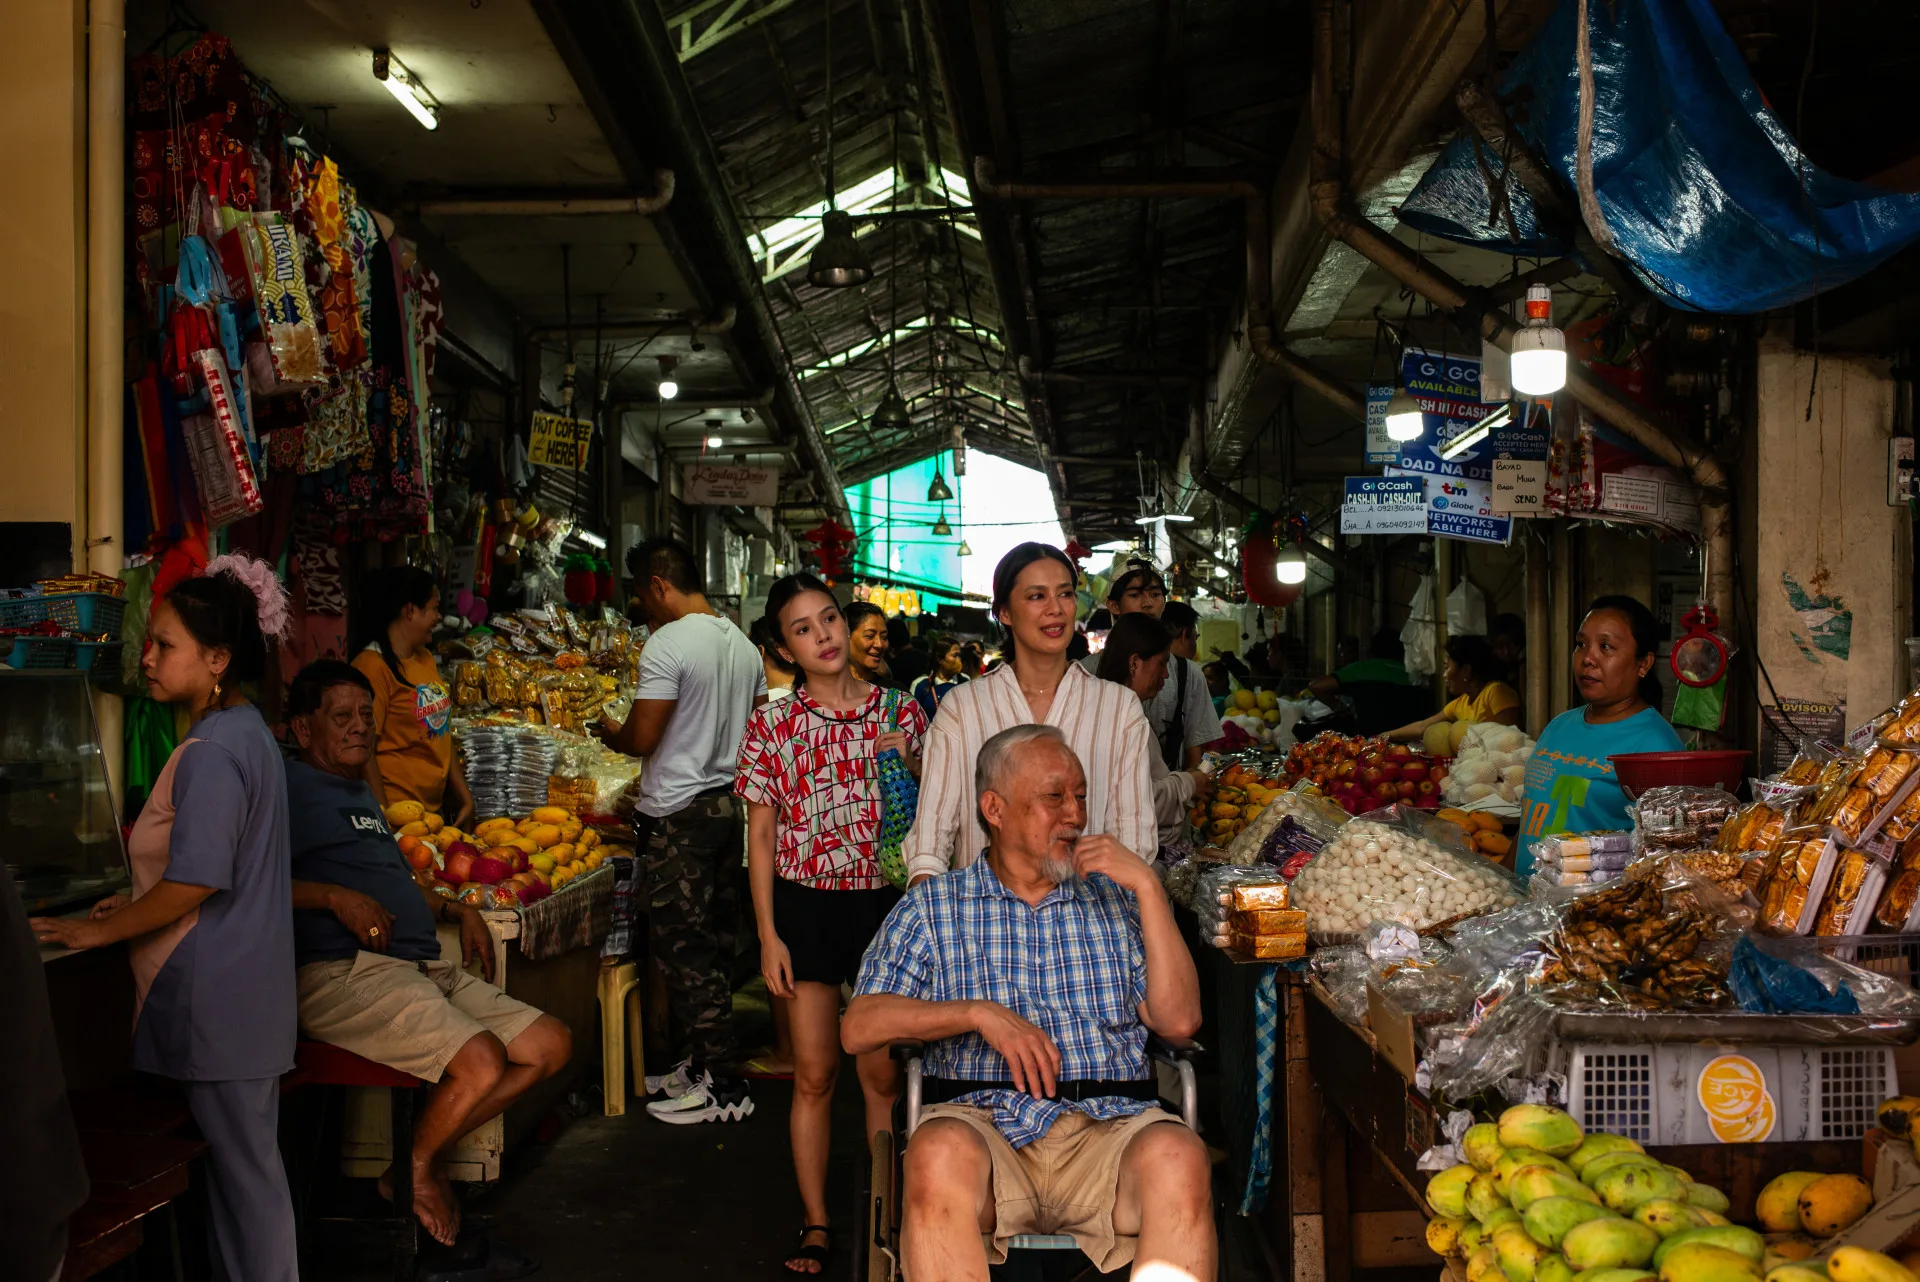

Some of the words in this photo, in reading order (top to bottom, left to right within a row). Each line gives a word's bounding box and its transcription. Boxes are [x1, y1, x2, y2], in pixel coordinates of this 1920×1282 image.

[1408, 379, 1479, 398] AVAILABLE
[1457, 405, 1488, 420] CASH
[533, 415, 555, 436] HOT
[1513, 432, 1546, 442] GCash
[1492, 440, 1529, 449] ACCEPTED
[545, 439, 577, 467] HERE
[1400, 457, 1436, 473] OAD
[1440, 462, 1464, 477] NA
[1377, 481, 1414, 491] GCash
[1450, 501, 1475, 512] Globe
[1514, 495, 1539, 504] SEND
[1427, 511, 1495, 529] NETWORKS
[1465, 526, 1500, 540] HERE
[1773, 702, 1836, 714] ADVISORY
[1707, 1080, 1756, 1102] ACE
